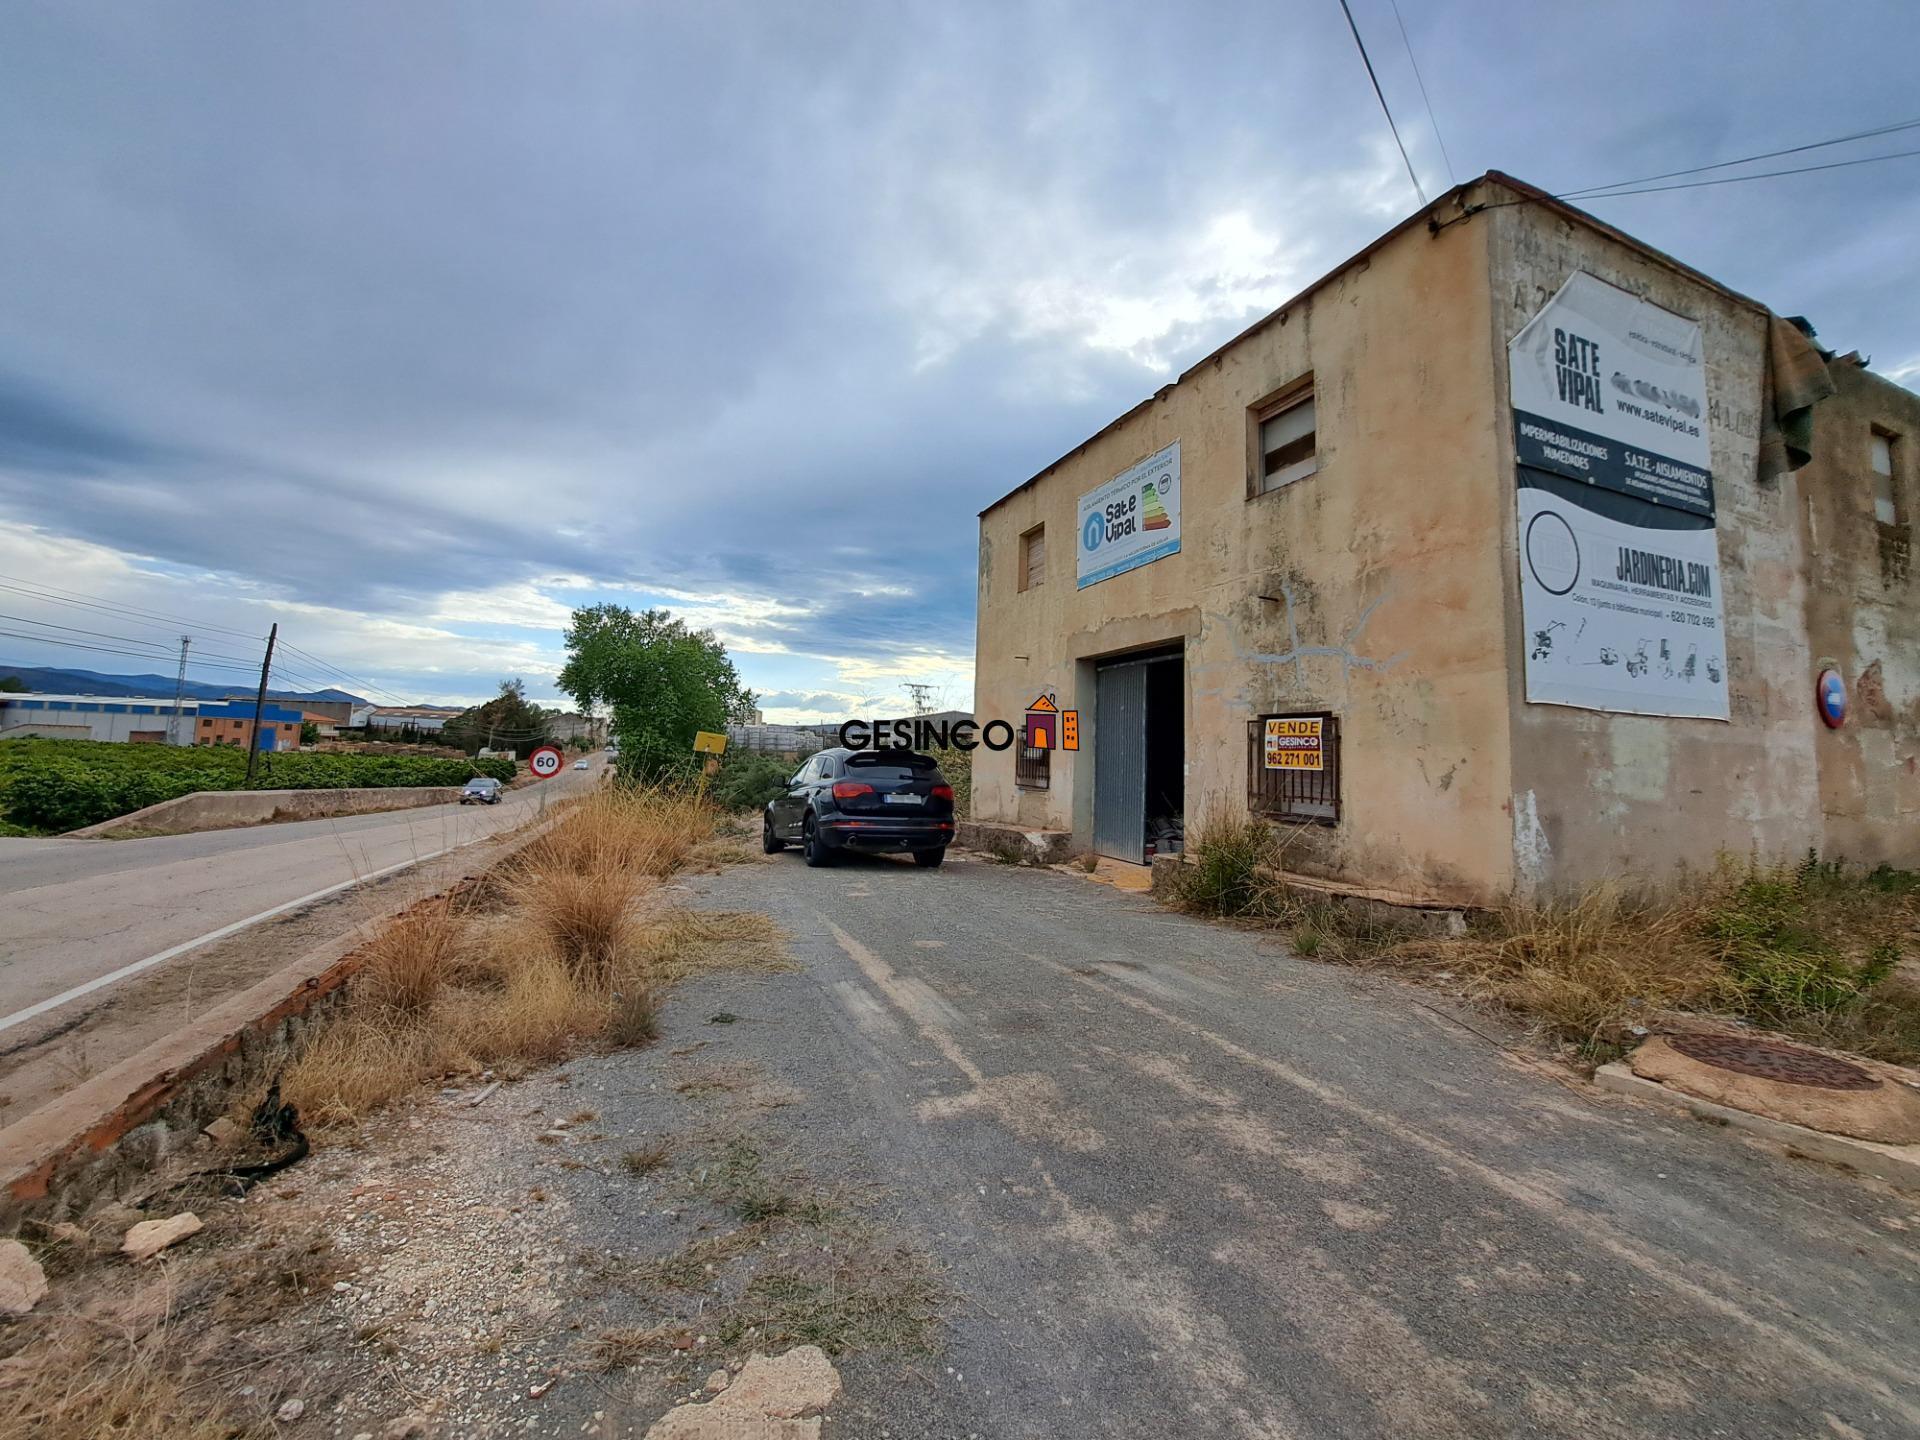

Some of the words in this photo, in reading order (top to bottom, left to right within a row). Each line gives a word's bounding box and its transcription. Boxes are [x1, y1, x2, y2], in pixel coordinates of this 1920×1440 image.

[1554, 327, 1600, 378] SATE
[1555, 364, 1604, 415] VIPAL
[1616, 399, 1700, 438] www.satevipal.es
[1520, 421, 1609, 461] IMPERMEABILIZACIONES
[1147, 457, 1173, 477] EXTERIOR
[1543, 444, 1590, 471] HUMEDADES
[1105, 494, 1137, 524] Sate
[1105, 516, 1137, 544] Vipal
[1616, 546, 1712, 598] JARDINERIA.COM
[1671, 610, 1686, 624] 620
[1268, 721, 1320, 734] VENDE
[1278, 736, 1319, 746] GESINCO
[536, 756, 556, 768] 60
[1266, 752, 1283, 765] 962
[1284, 752, 1300, 766] 271
[1303, 752, 1320, 766] 001
